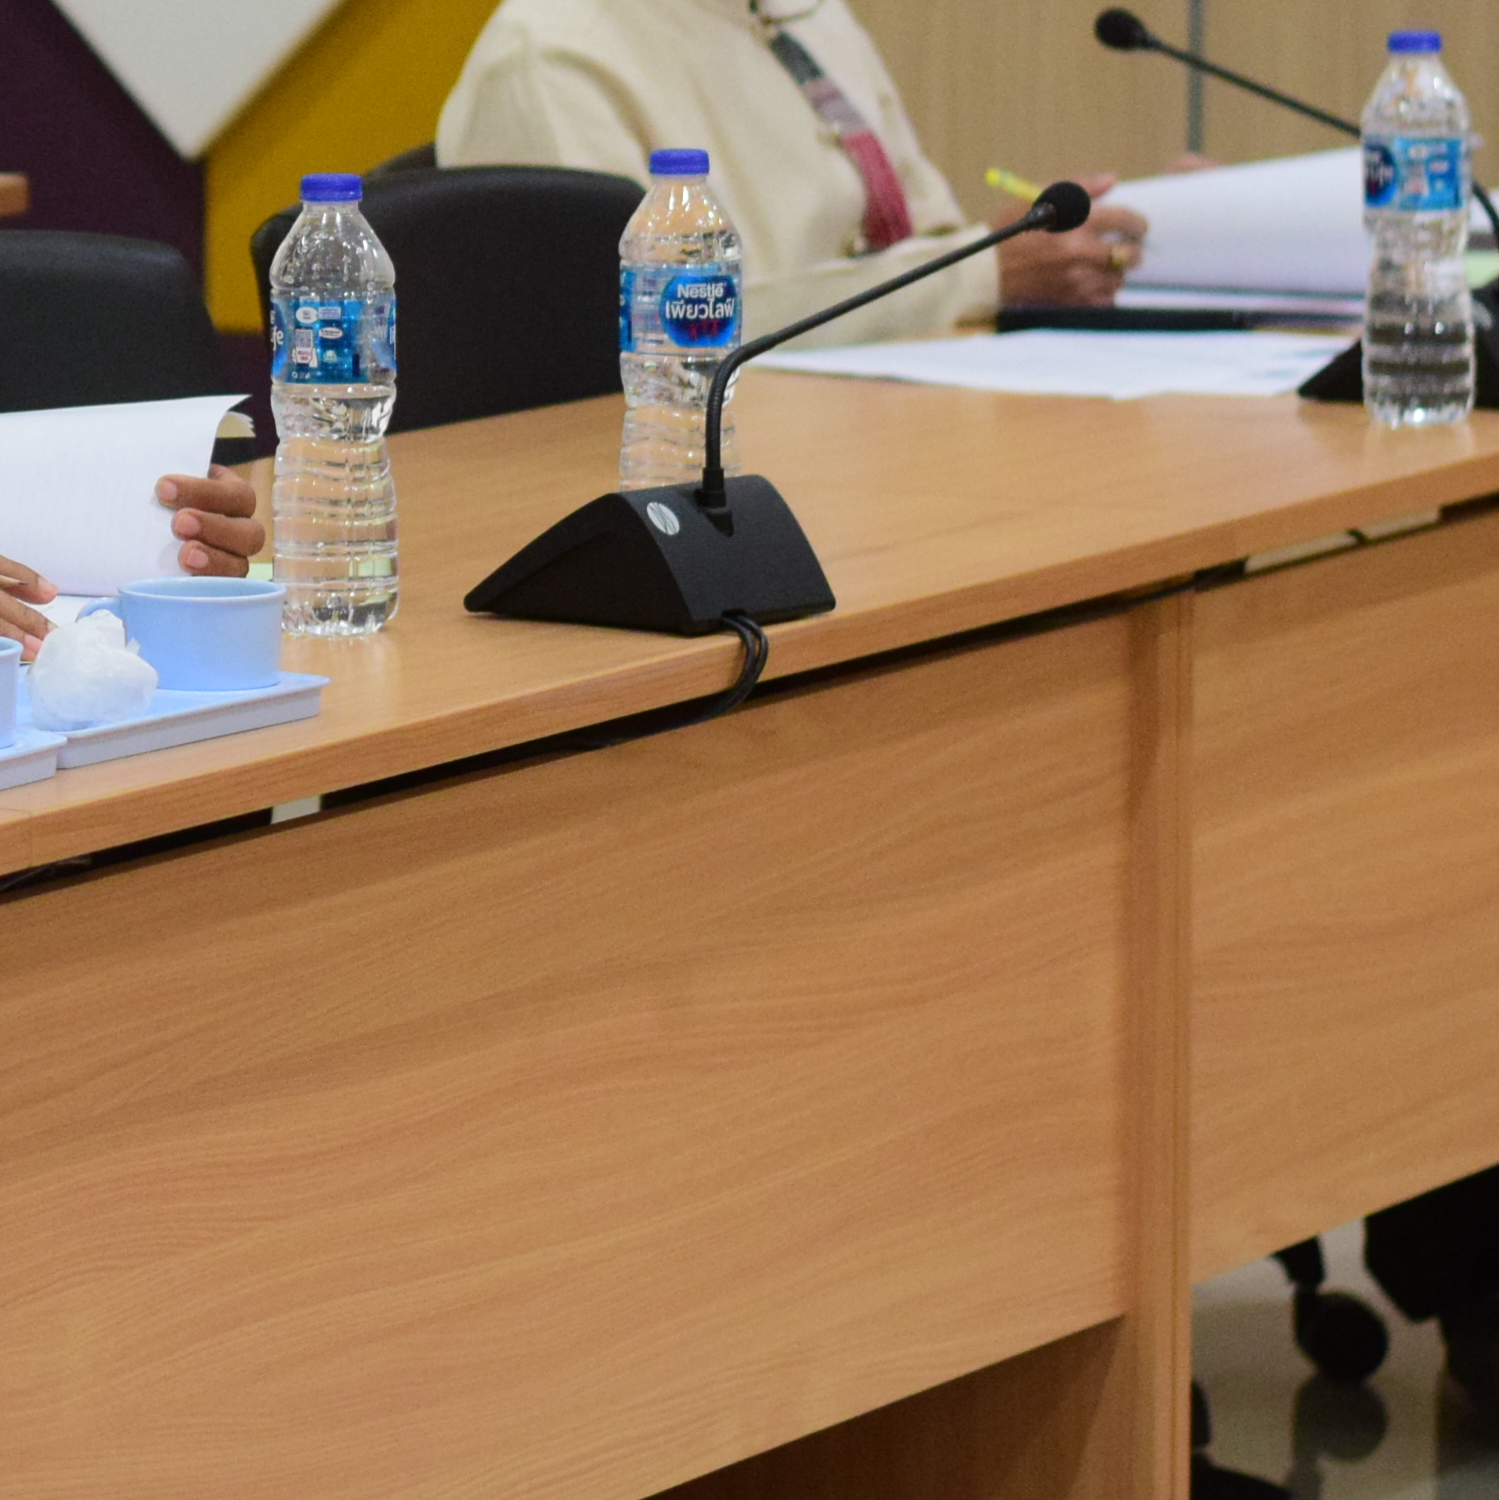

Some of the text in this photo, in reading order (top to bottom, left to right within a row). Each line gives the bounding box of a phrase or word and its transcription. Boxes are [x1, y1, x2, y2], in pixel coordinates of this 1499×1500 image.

[677, 283, 724, 299] Nestlé
[665, 298, 735, 319] เพียวไลฟ์
